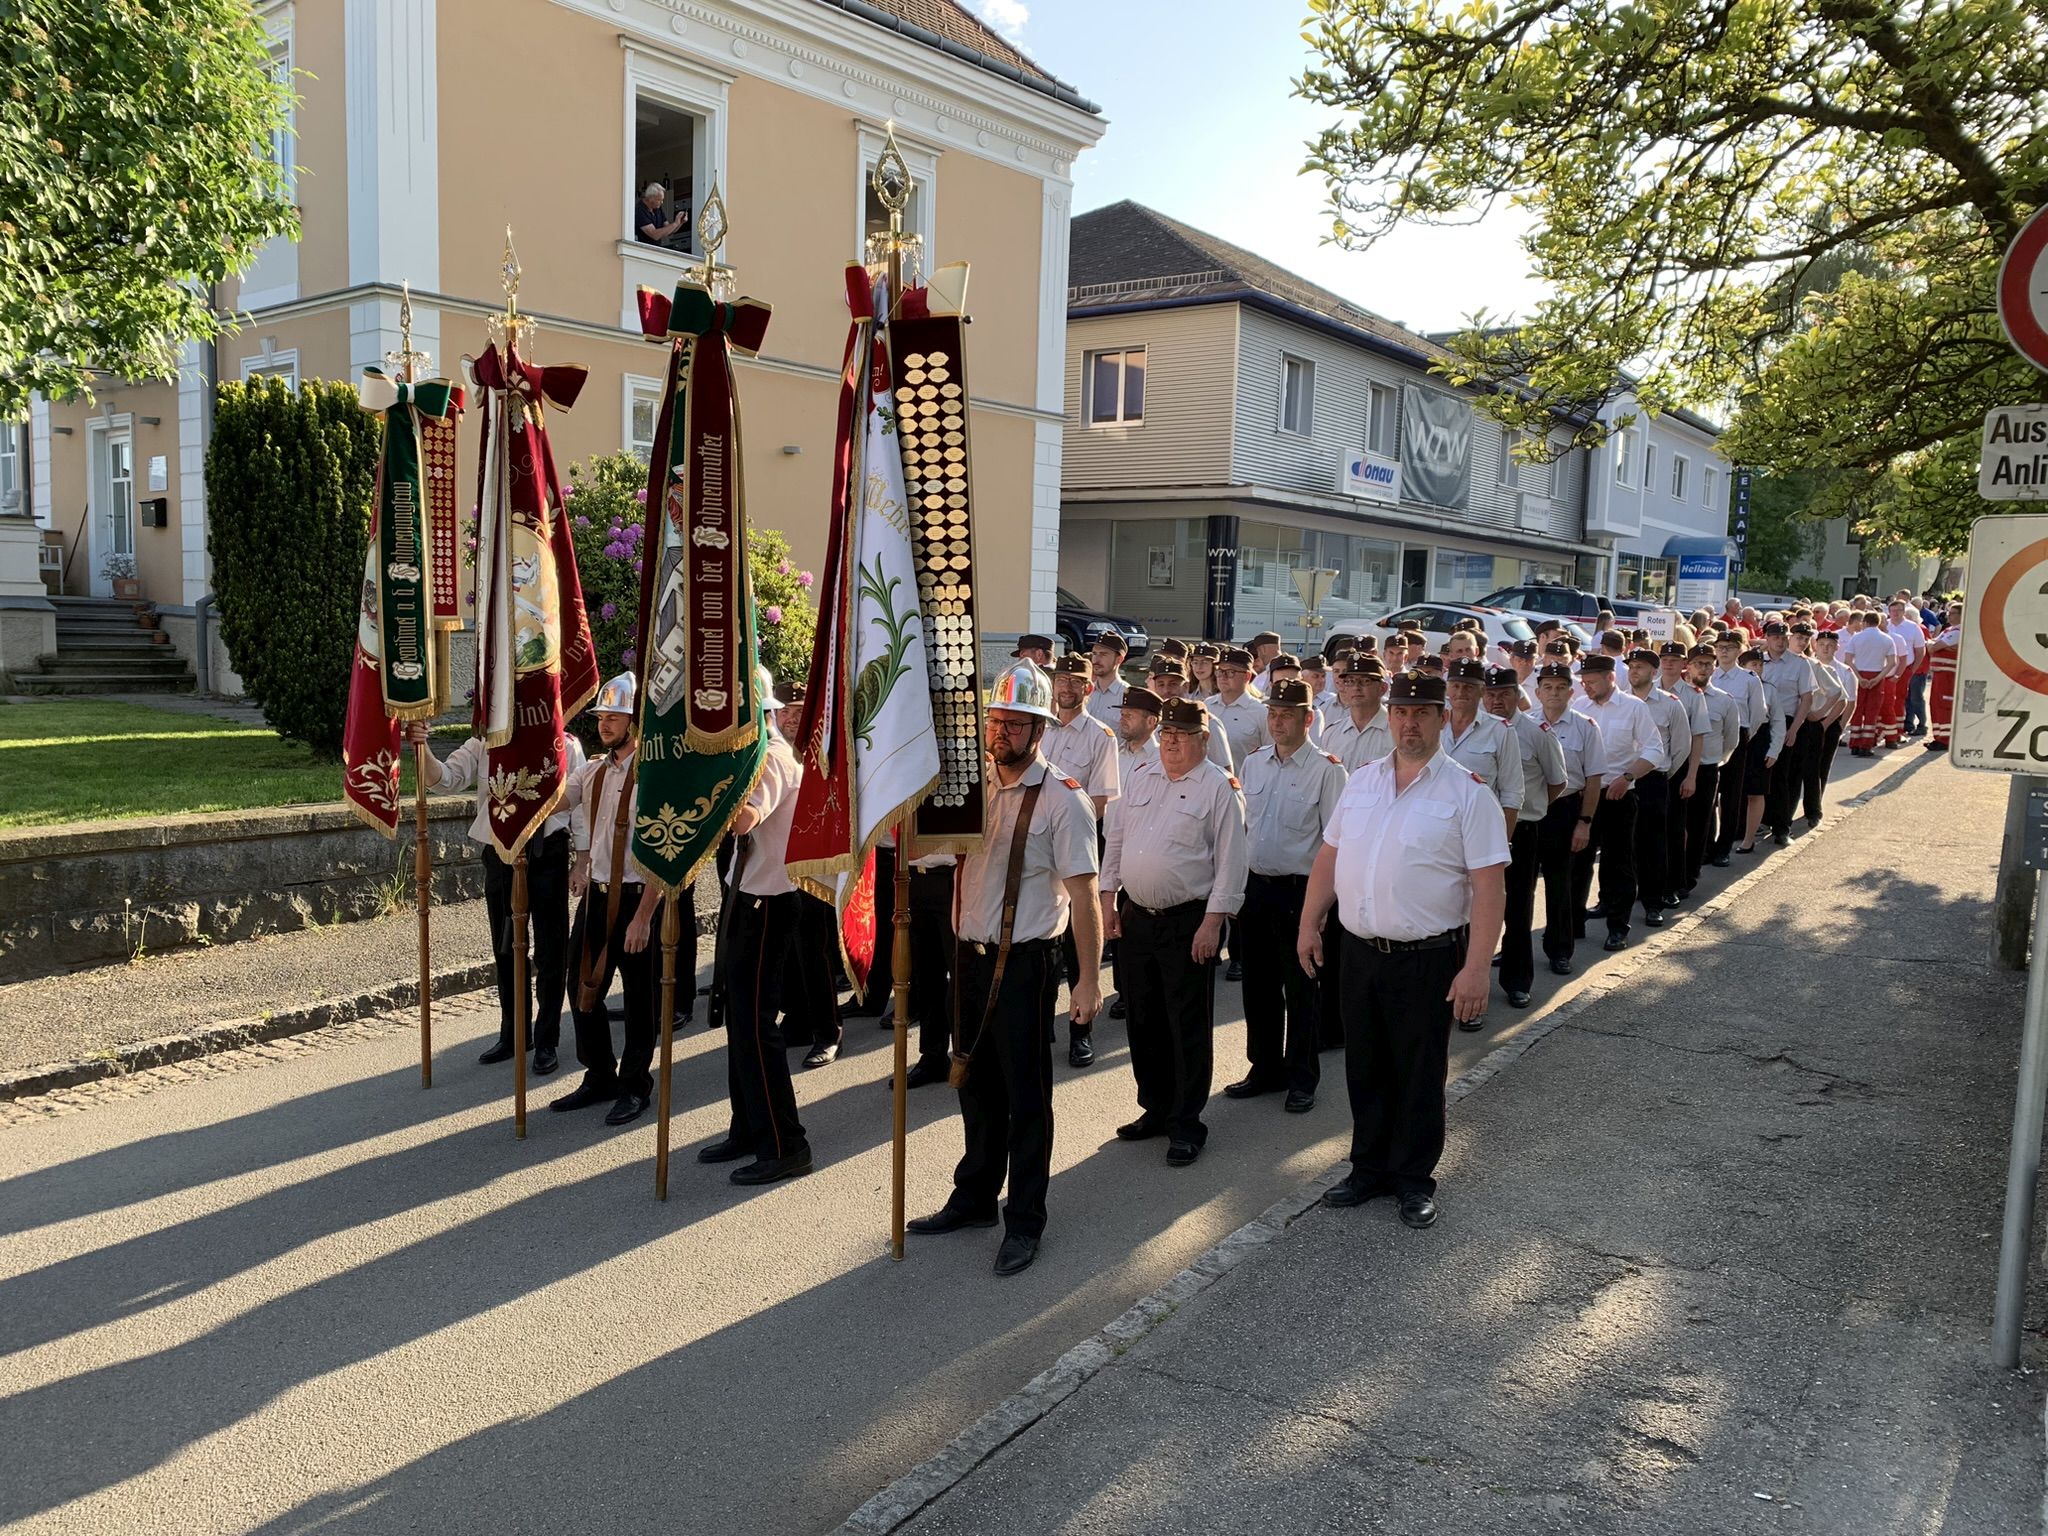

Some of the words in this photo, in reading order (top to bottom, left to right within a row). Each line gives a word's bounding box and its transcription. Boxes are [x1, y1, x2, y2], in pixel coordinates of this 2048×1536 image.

[1989, 413, 2048, 446] Aus
[692, 433, 730, 549] Fahnenmutter
[696, 560, 723, 583] der
[1681, 564, 1723, 574] Hellauer
[702, 592, 723, 619] von
[1647, 616, 1666, 625] Rotes
[694, 627, 728, 711] Gewidmet
